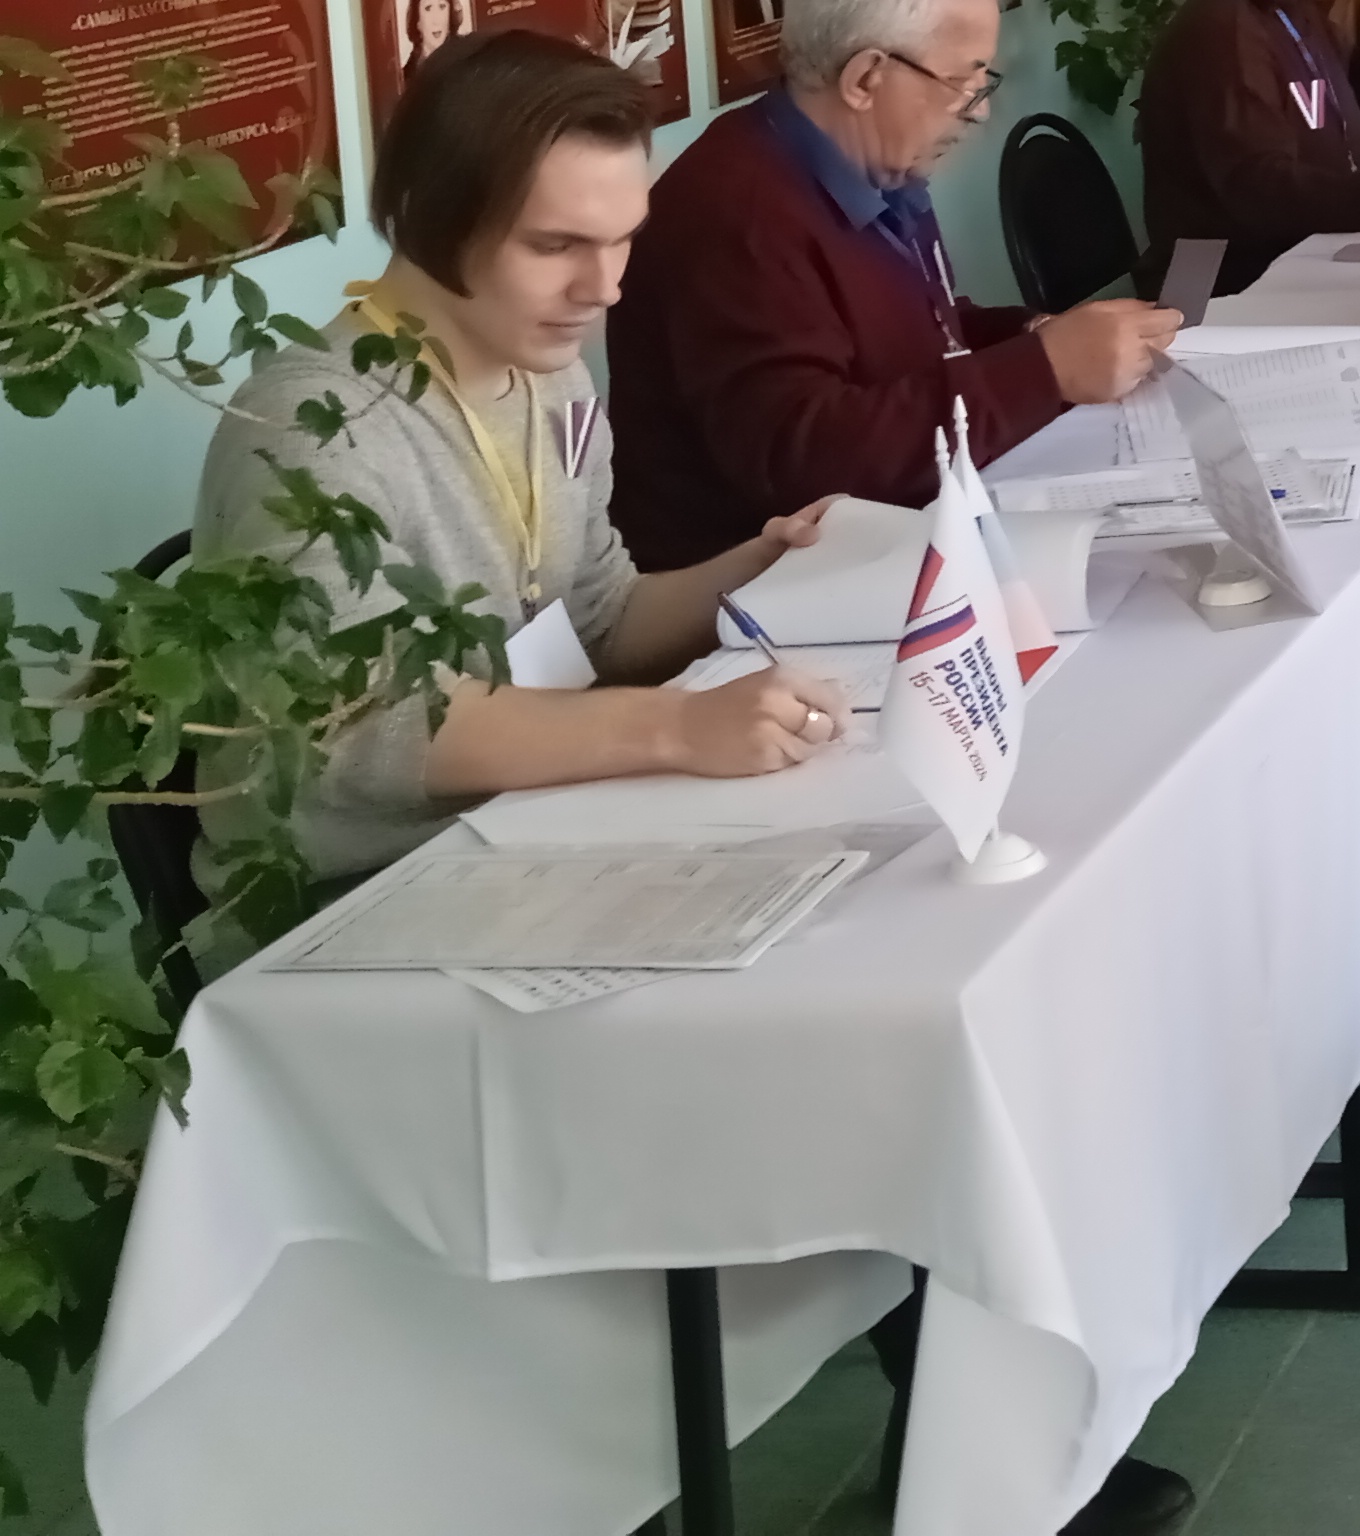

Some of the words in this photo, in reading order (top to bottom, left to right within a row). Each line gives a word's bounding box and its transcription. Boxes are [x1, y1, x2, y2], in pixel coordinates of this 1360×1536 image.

[934, 659, 983, 731] РОССИИ
[959, 647, 1008, 757] ПРЕЗИДЕНТА
[975, 636, 1007, 712] ВЫБОРЫ
[939, 707, 974, 752] МАРТА
